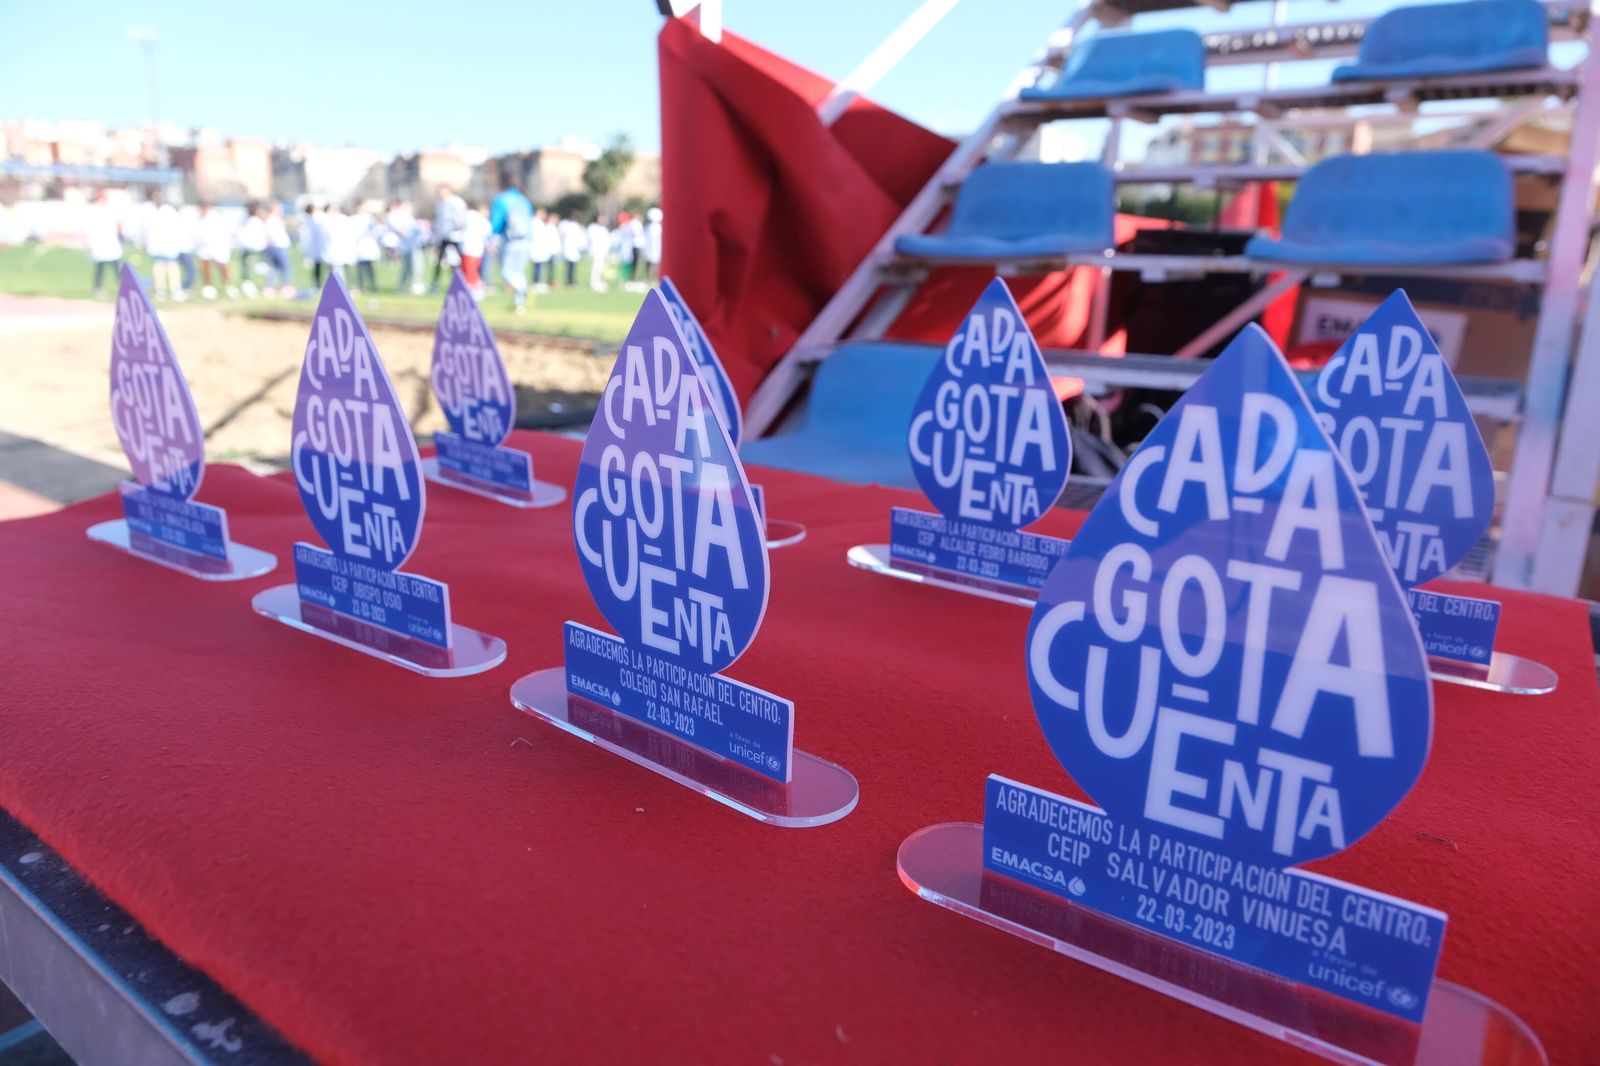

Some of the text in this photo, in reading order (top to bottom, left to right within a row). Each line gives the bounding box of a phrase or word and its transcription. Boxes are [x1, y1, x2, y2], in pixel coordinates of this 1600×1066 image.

[113, 290, 165, 365] CADA
[305, 307, 379, 401] CADA
[440, 291, 486, 346] CADA
[945, 307, 1035, 387] CADA
[117, 359, 193, 443] GOTA
[432, 362, 504, 444] CUENTA
[439, 341, 506, 406] GOTA
[604, 336, 711, 457] CADA
[1316, 324, 1448, 419] CADA
[111, 388, 195, 495] CUENTA
[306, 395, 411, 501] GOTA
[908, 410, 1041, 526] CUENTA
[935, 380, 1057, 472] GOTA
[294, 430, 407, 563] CUENTA
[600, 444, 749, 589] GOTA
[1118, 392, 1346, 571] CADA
[940, 536, 976, 557] ALCALDE
[978, 543, 1006, 563] PEDRO
[949, 520, 959, 535] LA
[574, 487, 735, 665] CUENTA
[1418, 594, 1439, 612] DEL
[570, 628, 781, 725] AGRADECEMOS LA PARTICIPACIÓN DEL CENTRO:
[571, 674, 611, 700] EMACSA
[1092, 542, 1395, 759] GOTA
[1424, 640, 1470, 656] unicef
[619, 668, 724, 726] COLEGIO SAN RAFAEL
[646, 699, 695, 737] 22-03-2023
[1029, 600, 1346, 857] CUENTA
[729, 741, 766, 766] unicef
[992, 846, 1066, 887] EMACSA
[996, 784, 1432, 948] AGRADECEMOS LA PARTICIPACIÓN DEL CENTRO:
[1048, 832, 1091, 867] CEIP
[1106, 851, 1230, 918] SALVADOR
[1242, 895, 1347, 956] VINUESA
[1136, 893, 1236, 951] 22-03-2023
[1308, 962, 1386, 1000] unicef
